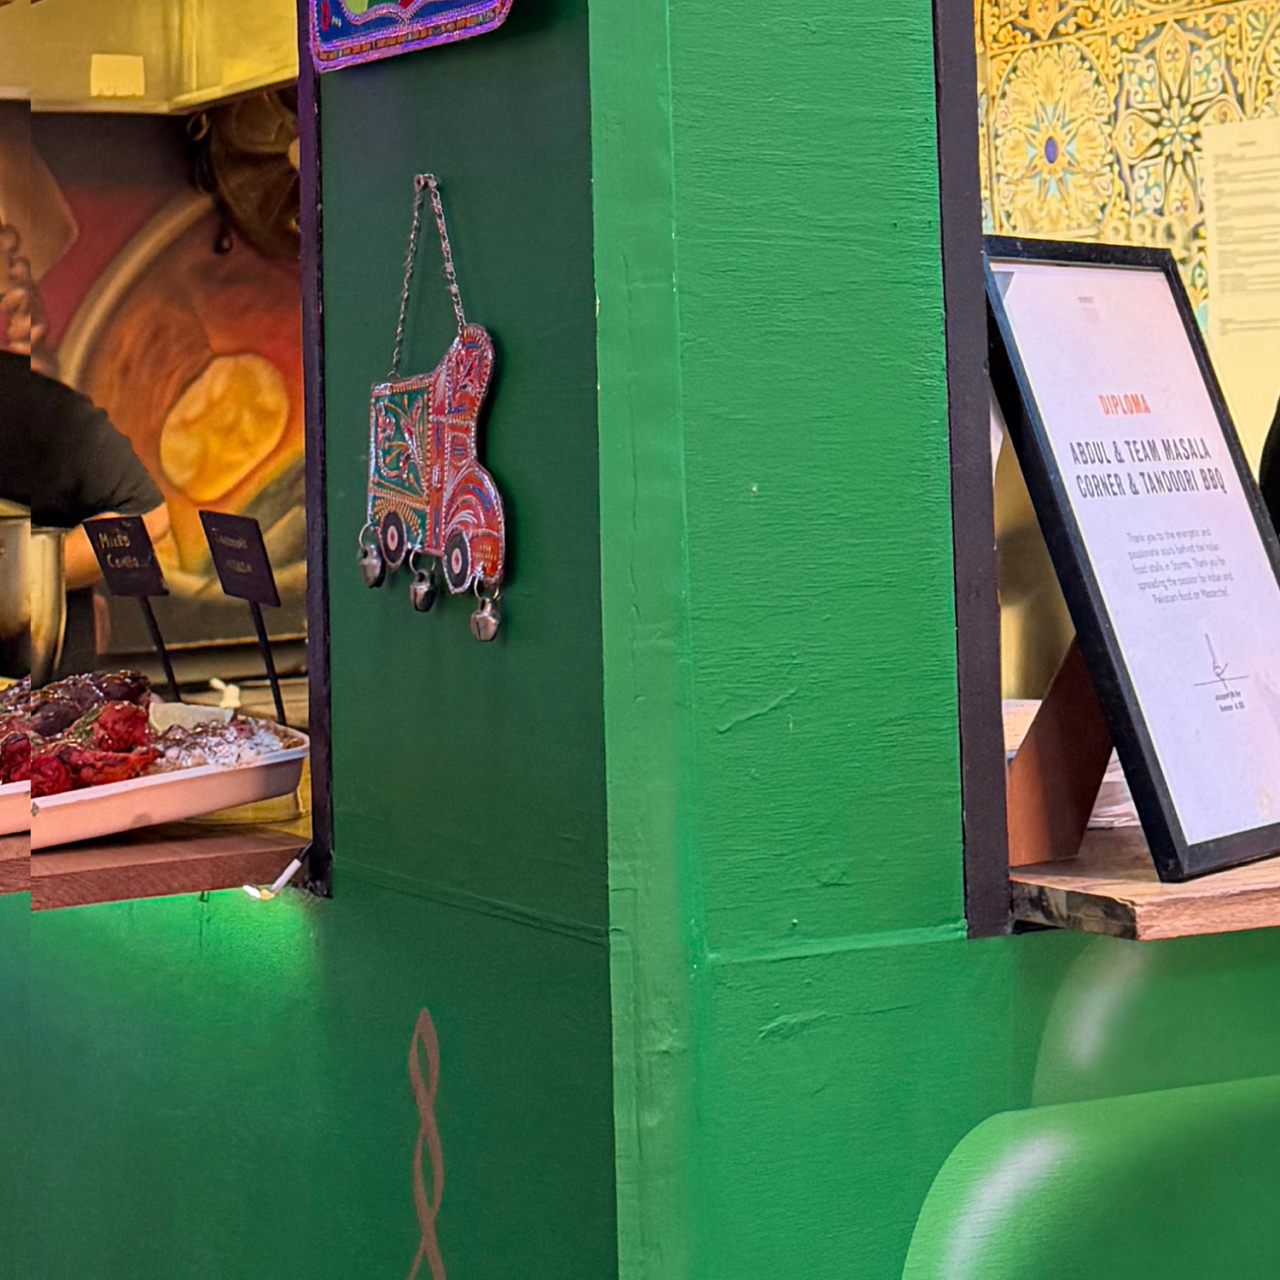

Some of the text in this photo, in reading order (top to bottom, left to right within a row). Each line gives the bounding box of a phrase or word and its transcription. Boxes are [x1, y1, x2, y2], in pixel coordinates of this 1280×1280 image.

[1099, 393, 1151, 416] DIPLOMA
[1069, 437, 1212, 466] ABDUL & TEAM MASALA
[1075, 467, 1228, 499] CORNER & TANDOORI BBQ
